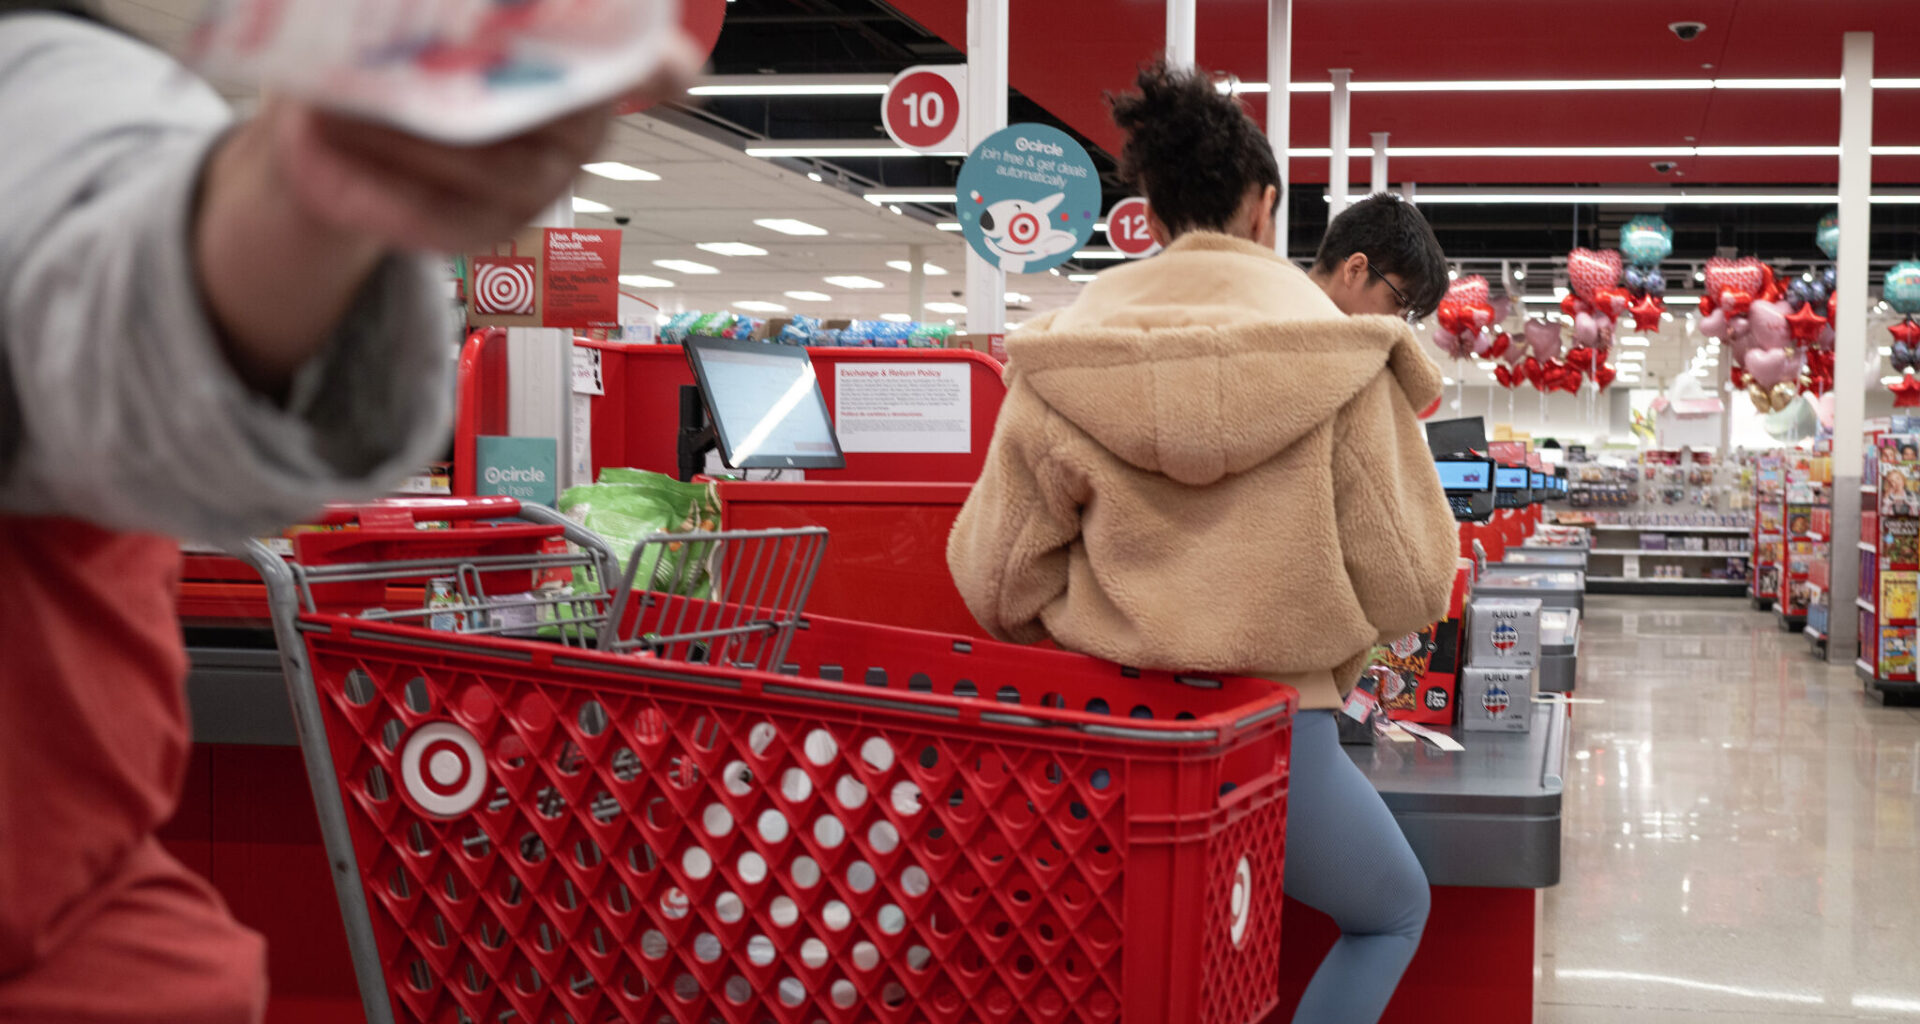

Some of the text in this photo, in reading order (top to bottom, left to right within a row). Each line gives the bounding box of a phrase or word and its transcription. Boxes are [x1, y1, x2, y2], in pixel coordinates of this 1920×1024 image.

[902, 91, 945, 128] 10
[1028, 139, 1064, 157] circle
[980, 146, 1088, 178] join free & get deals
[996, 165, 1068, 190] automatically
[1119, 214, 1151, 240] 12
[840, 369, 879, 378] Exchange
[888, 369, 916, 377] Return
[917, 368, 943, 377] Policy
[501, 466, 546, 482] circle
[509, 485, 535, 497] here
